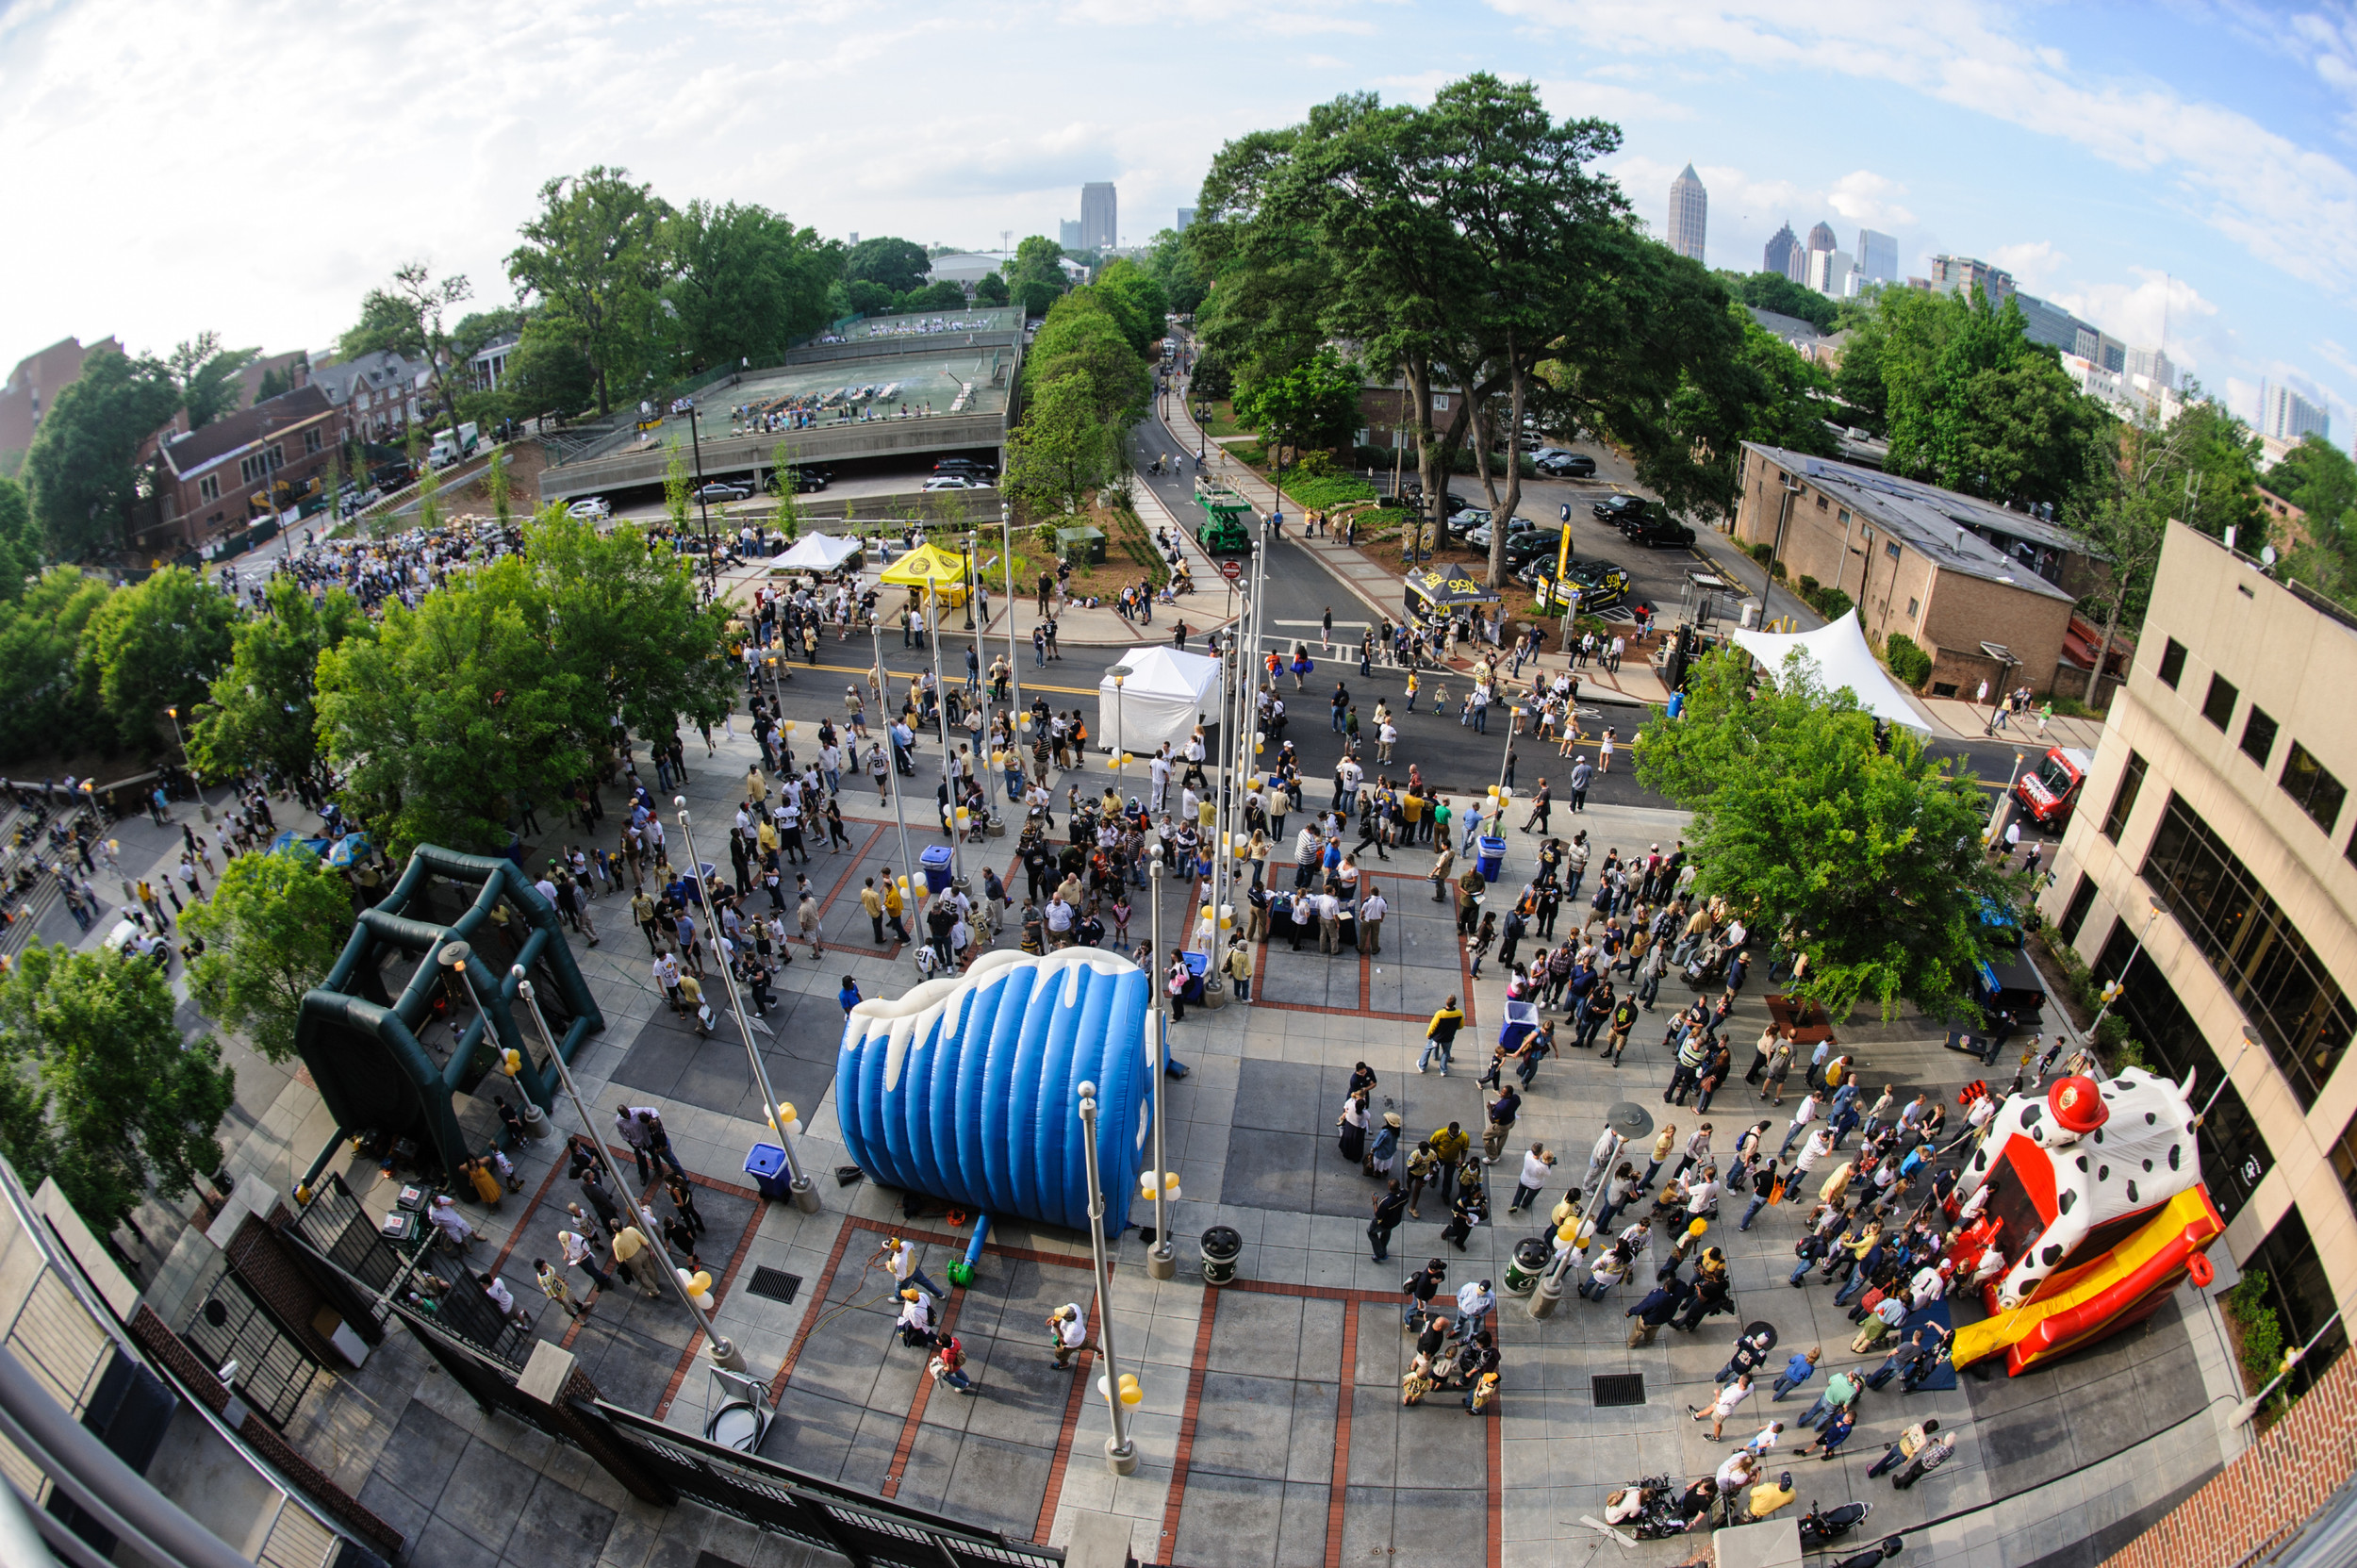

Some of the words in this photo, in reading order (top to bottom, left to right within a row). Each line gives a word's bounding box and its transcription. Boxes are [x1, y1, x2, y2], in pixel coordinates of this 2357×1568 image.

[1448, 577, 1480, 595] 99X
[1607, 571, 1622, 590] 99X
[1047, 625, 1052, 634] 9
[874, 759, 884, 768] 21
[1346, 770, 1353, 782] 9
[944, 900, 958, 913] 22
[1920, 1278, 1932, 1292] 1
